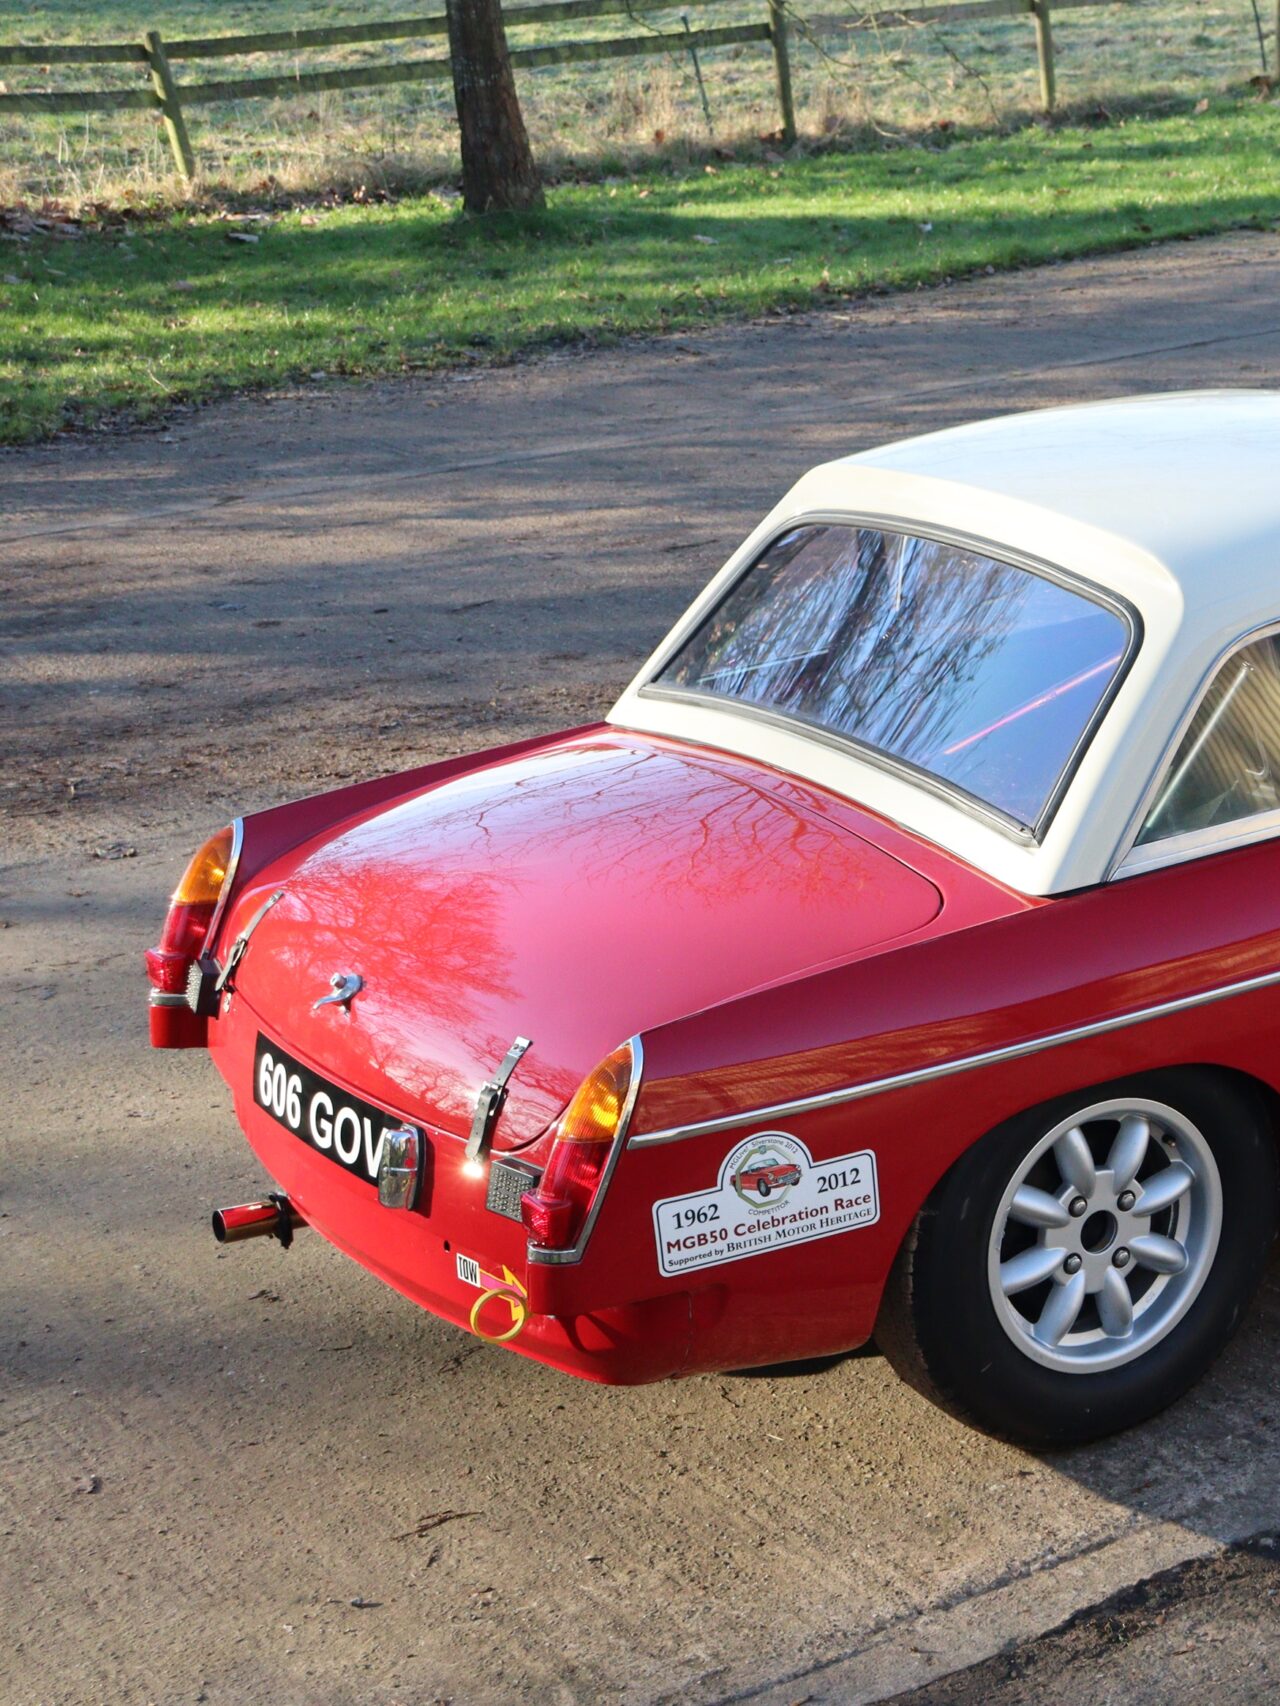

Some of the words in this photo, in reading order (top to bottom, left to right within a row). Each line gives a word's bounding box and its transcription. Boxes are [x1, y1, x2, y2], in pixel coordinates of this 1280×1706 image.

[259, 1052, 303, 1129] 606
[309, 1091, 390, 1179] GOV
[751, 1138, 784, 1148] Silverstone
[784, 1141, 799, 1155] 2012
[817, 1167, 861, 1194] 2012
[672, 1203, 720, 1230] 1962
[747, 1199, 791, 1216] COMPETITOR
[666, 1228, 728, 1254] MGB50
[733, 1206, 829, 1237] Celebration
[833, 1193, 872, 1212] Race
[668, 1250, 713, 1267] Supported
[715, 1246, 725, 1257] by
[726, 1234, 772, 1252] BRITISH
[774, 1221, 817, 1241] MOTOR
[819, 1207, 873, 1228] HERITAGE
[458, 1256, 477, 1284] TOW
